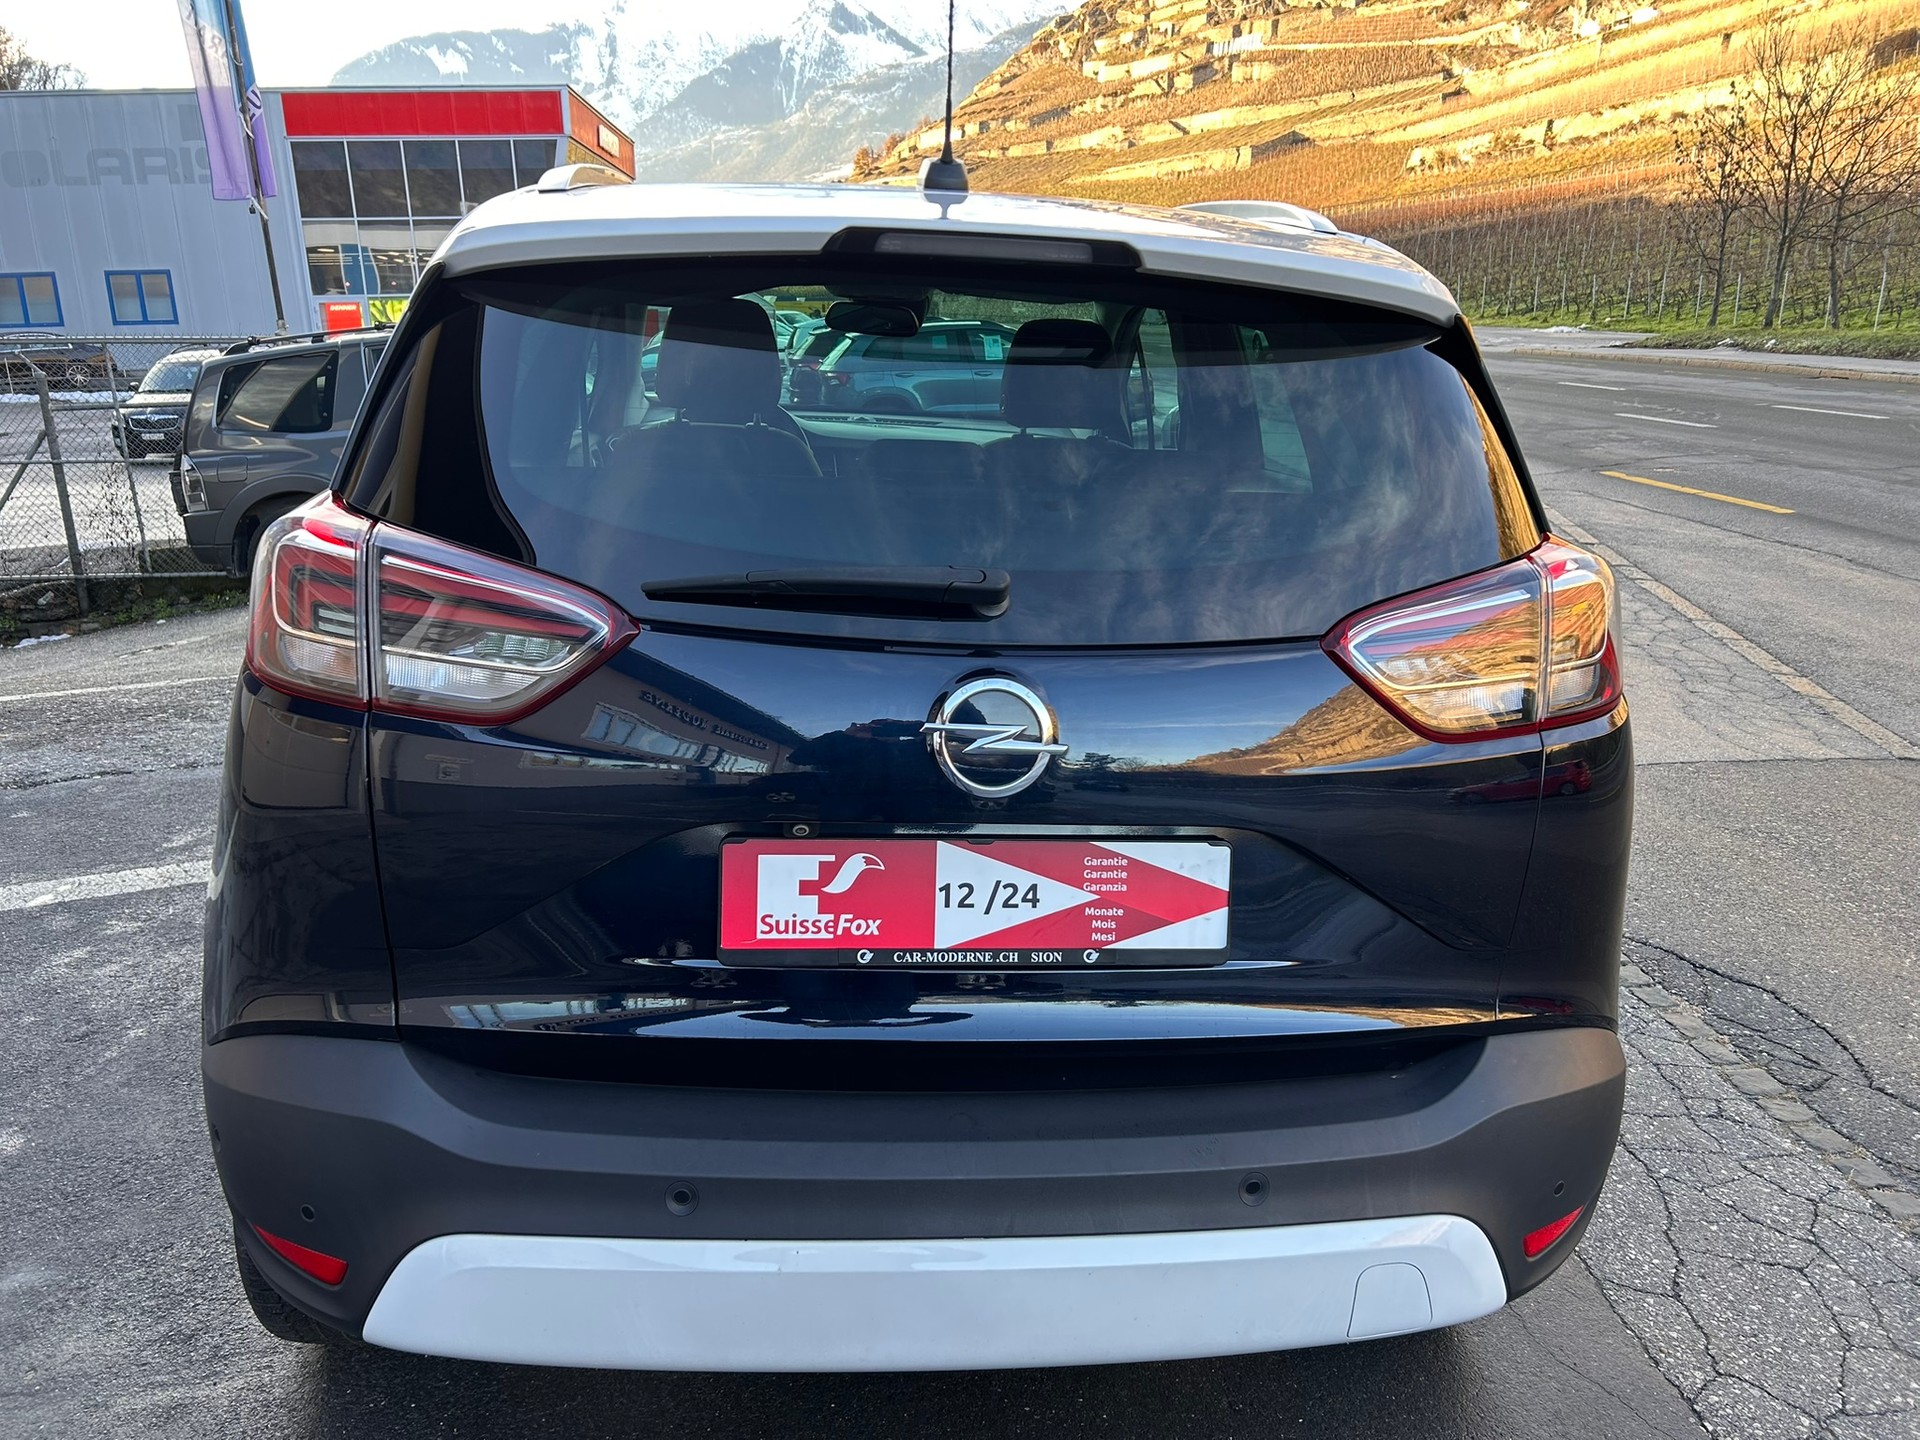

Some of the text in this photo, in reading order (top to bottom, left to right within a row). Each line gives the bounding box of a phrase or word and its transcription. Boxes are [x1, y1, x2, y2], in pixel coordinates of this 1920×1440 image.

[960, 679, 1032, 699] OPEL
[1084, 857, 1128, 866] Garantie
[1083, 869, 1128, 879] Garantie
[1083, 882, 1127, 892] Garanzia
[938, 880, 1040, 915] 12 /24
[1085, 907, 1124, 916] Monate
[759, 913, 882, 936] SuisseFox
[1091, 919, 1117, 929] Mois
[1091, 931, 1116, 942] Mesi
[1030, 951, 1063, 963] SION
